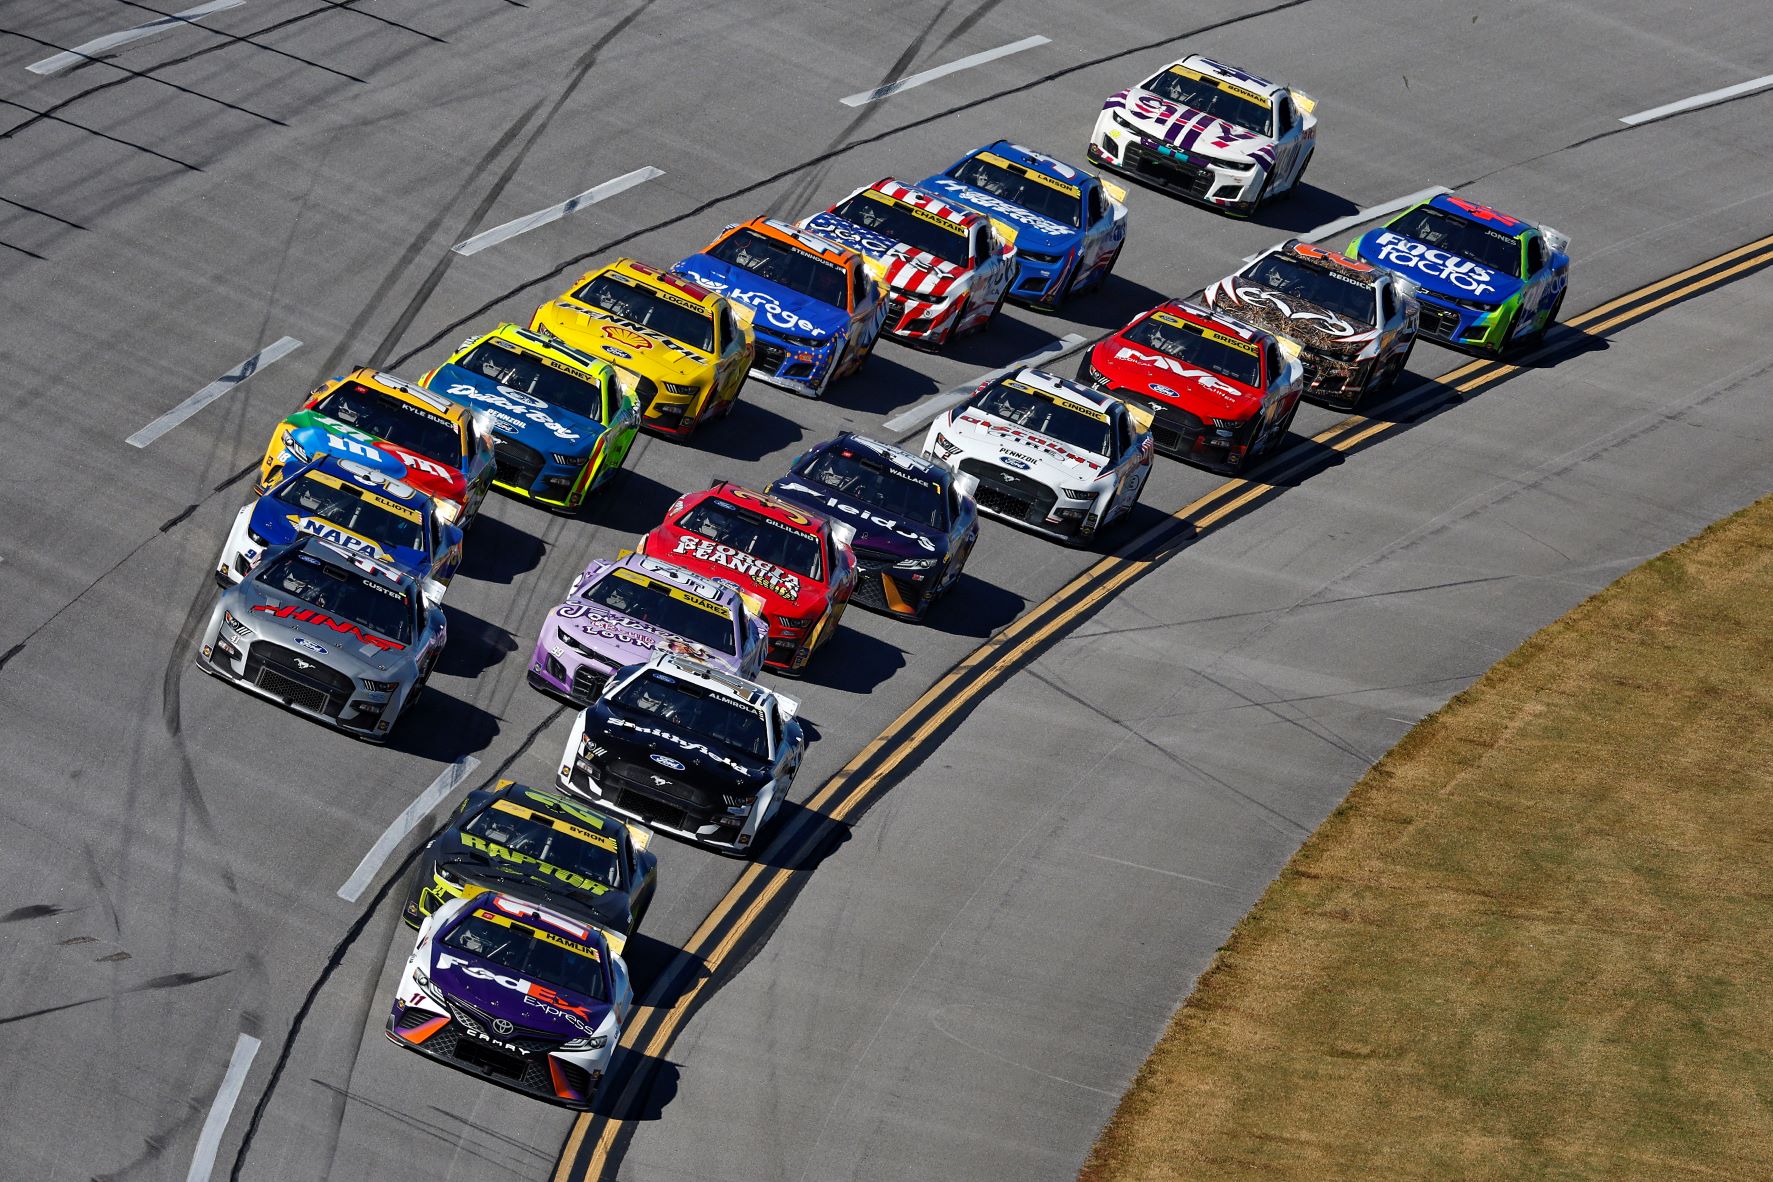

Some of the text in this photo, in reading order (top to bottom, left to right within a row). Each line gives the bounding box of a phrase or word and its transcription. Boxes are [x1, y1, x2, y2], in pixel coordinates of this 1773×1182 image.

[1228, 84, 1266, 104] BOWMAN
[1037, 174, 1073, 192] LARSON
[913, 208, 965, 234] CHASTAIN
[1484, 230, 1517, 247] JONES
[791, 246, 834, 268] STENHOUSE
[1376, 232, 1495, 282] Focus
[1378, 242, 1495, 296] factor
[1328, 271, 1372, 291] REDDICK
[662, 293, 705, 314] LOGANO
[731, 288, 826, 336] Kroger
[1213, 333, 1258, 354] BRISCOE
[550, 361, 592, 382] BLANEY
[402, 403, 455, 429] KYLE BUSCH
[488, 408, 527, 429] PENNZOIL
[1062, 401, 1102, 420] CINDRIC
[277, 450, 292, 463] 18
[327, 433, 383, 463] m
[941, 452, 951, 461] 2
[999, 446, 1040, 466] PENNZOIL
[999, 456, 1031, 471] Ford
[889, 467, 929, 488] WALLACE
[374, 495, 415, 517] ELLIOTT
[303, 519, 376, 559] NAPA
[765, 517, 814, 542] GILLILAND
[244, 548, 257, 560] 9
[679, 535, 800, 584] GEORGIA
[672, 541, 800, 594] PEANUTS
[362, 579, 402, 600] CUSTER
[708, 692, 758, 715] ALMIROLA
[649, 753, 686, 771] Ford
[569, 825, 606, 844] BYRON
[460, 832, 610, 896] RAPTOR
[546, 932, 594, 956] HAMLIN
[435, 951, 592, 1023] FedEx
[409, 992, 427, 1007] 11
[523, 994, 595, 1036] Express
[466, 1028, 531, 1056] CAMRY
